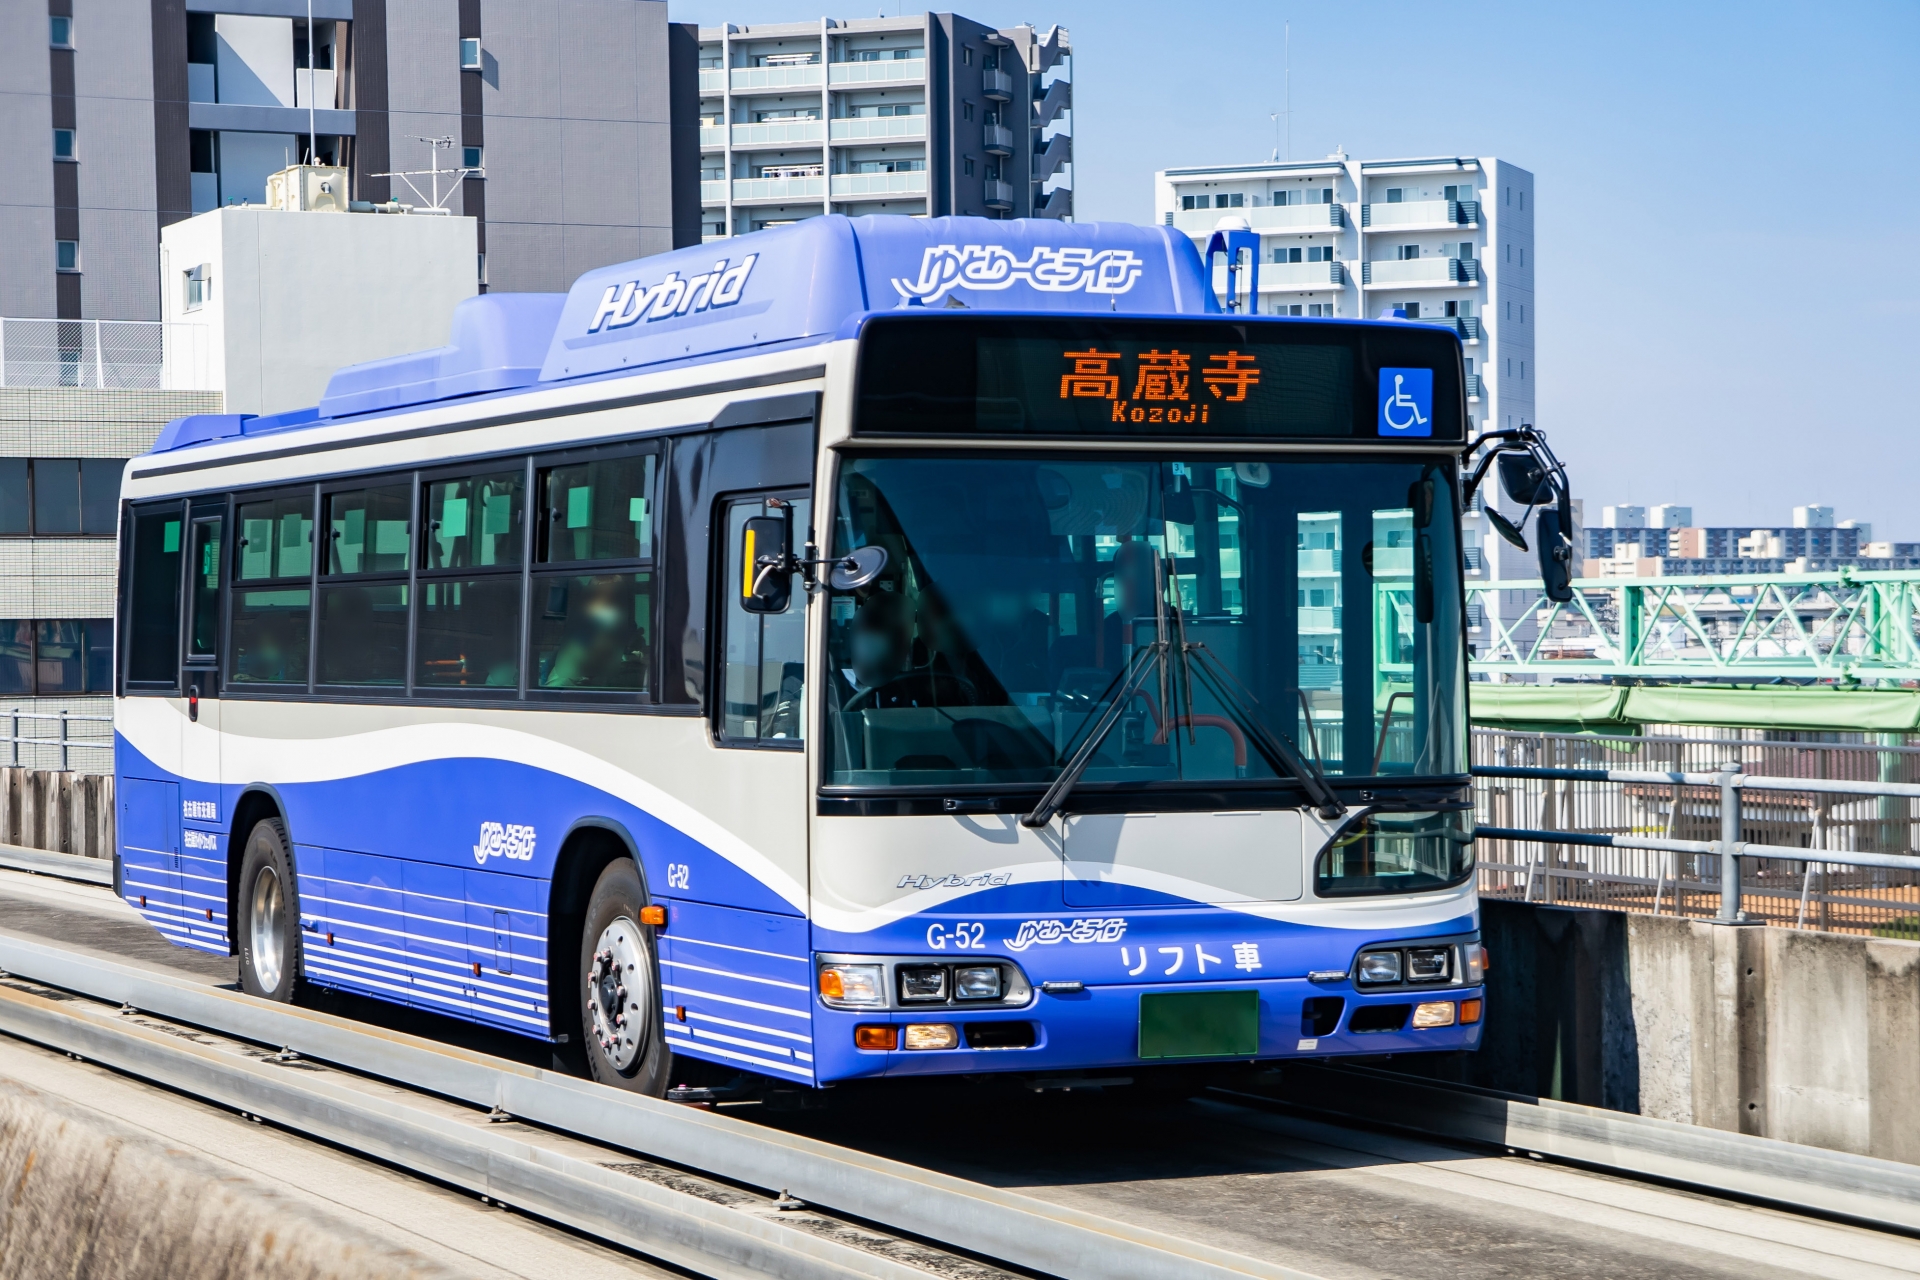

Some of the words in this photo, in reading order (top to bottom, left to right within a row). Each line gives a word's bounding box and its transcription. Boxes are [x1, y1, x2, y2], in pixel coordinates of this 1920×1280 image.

[587, 252, 760, 335] Hybrid
[1059, 348, 1261, 402] 高蔵寺
[1111, 400, 1209, 424] Kozoji
[667, 863, 690, 890] G-52
[896, 873, 1012, 890] Hybrid
[926, 922, 986, 950] G-52
[1120, 942, 1263, 977] リフト車
